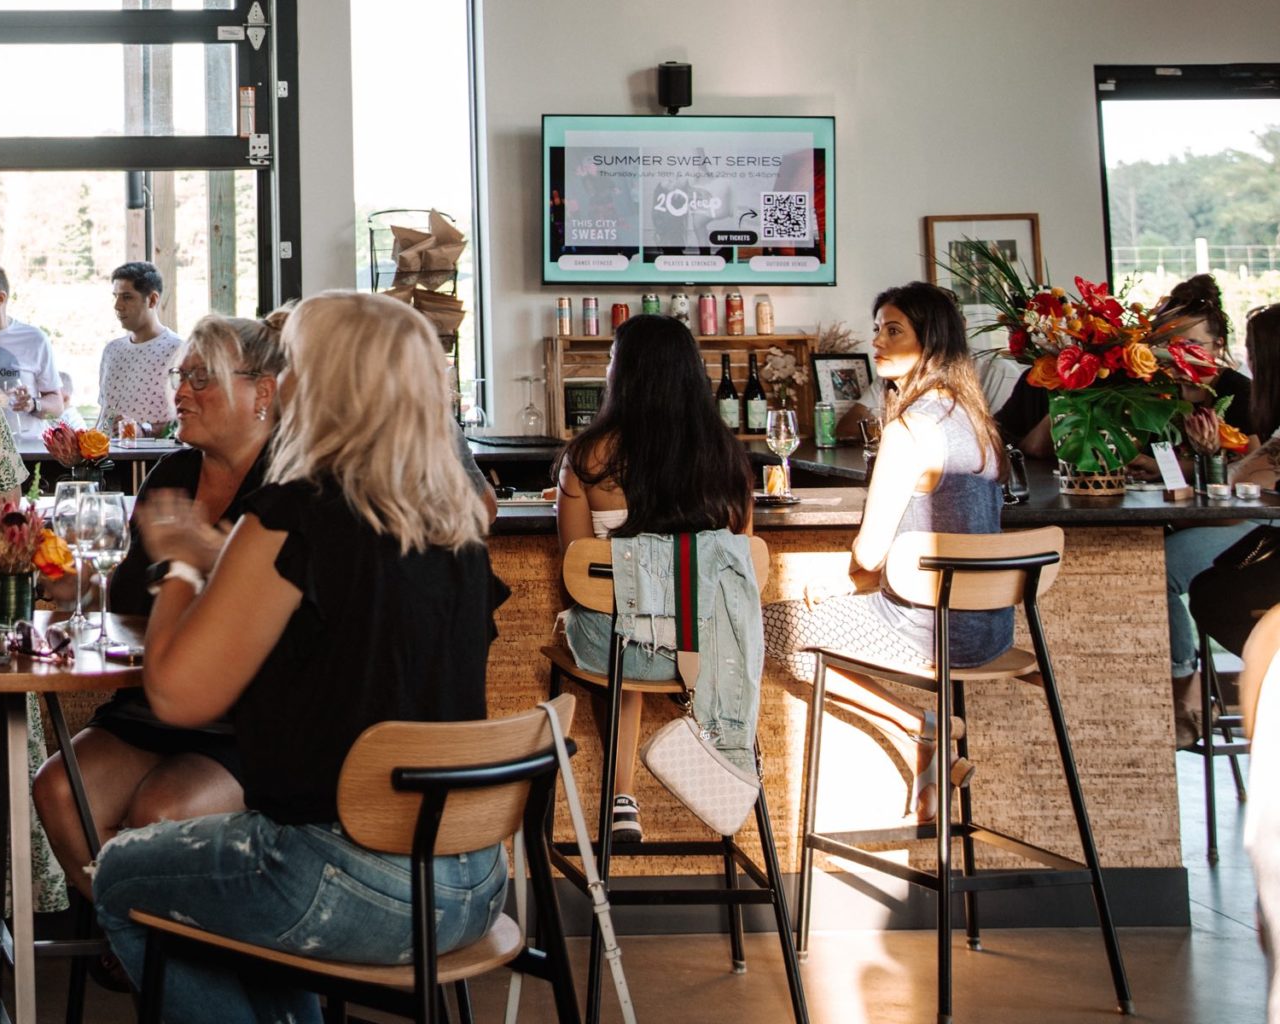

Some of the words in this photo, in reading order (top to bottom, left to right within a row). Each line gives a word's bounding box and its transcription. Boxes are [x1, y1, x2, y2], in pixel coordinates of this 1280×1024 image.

[593, 155, 662, 166] SUMMER
[667, 155, 721, 166] SWEAT
[726, 156, 782, 167] SERIES
[599, 170, 637, 178] Thursday
[685, 170, 713, 179] August
[571, 219, 592, 228] THIS
[595, 219, 617, 228] CITY
[571, 228, 617, 240] SWEATS
[717, 234, 728, 242] BUY
[729, 234, 751, 242] TICKETS
